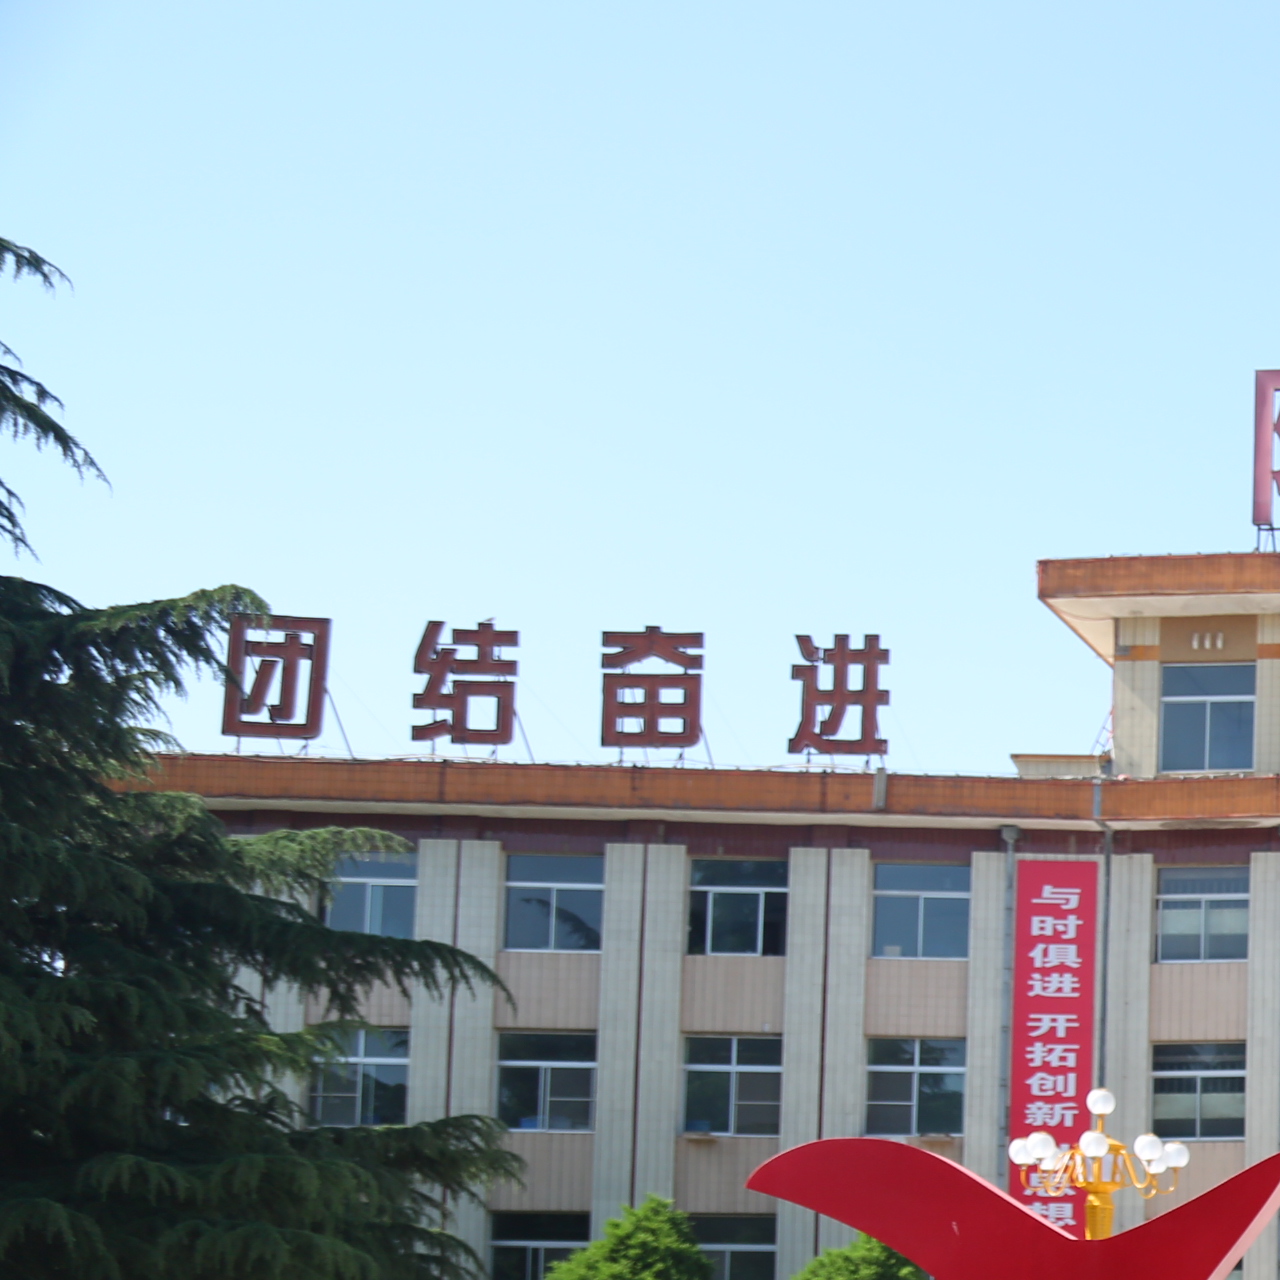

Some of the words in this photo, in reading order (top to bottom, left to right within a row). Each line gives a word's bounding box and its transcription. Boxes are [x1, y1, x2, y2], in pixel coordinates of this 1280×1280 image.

[222, 614, 890, 755] 团结奋进
[1027, 885, 1083, 998] 与时俱进
[1024, 1014, 1080, 1128] 开拓创新
